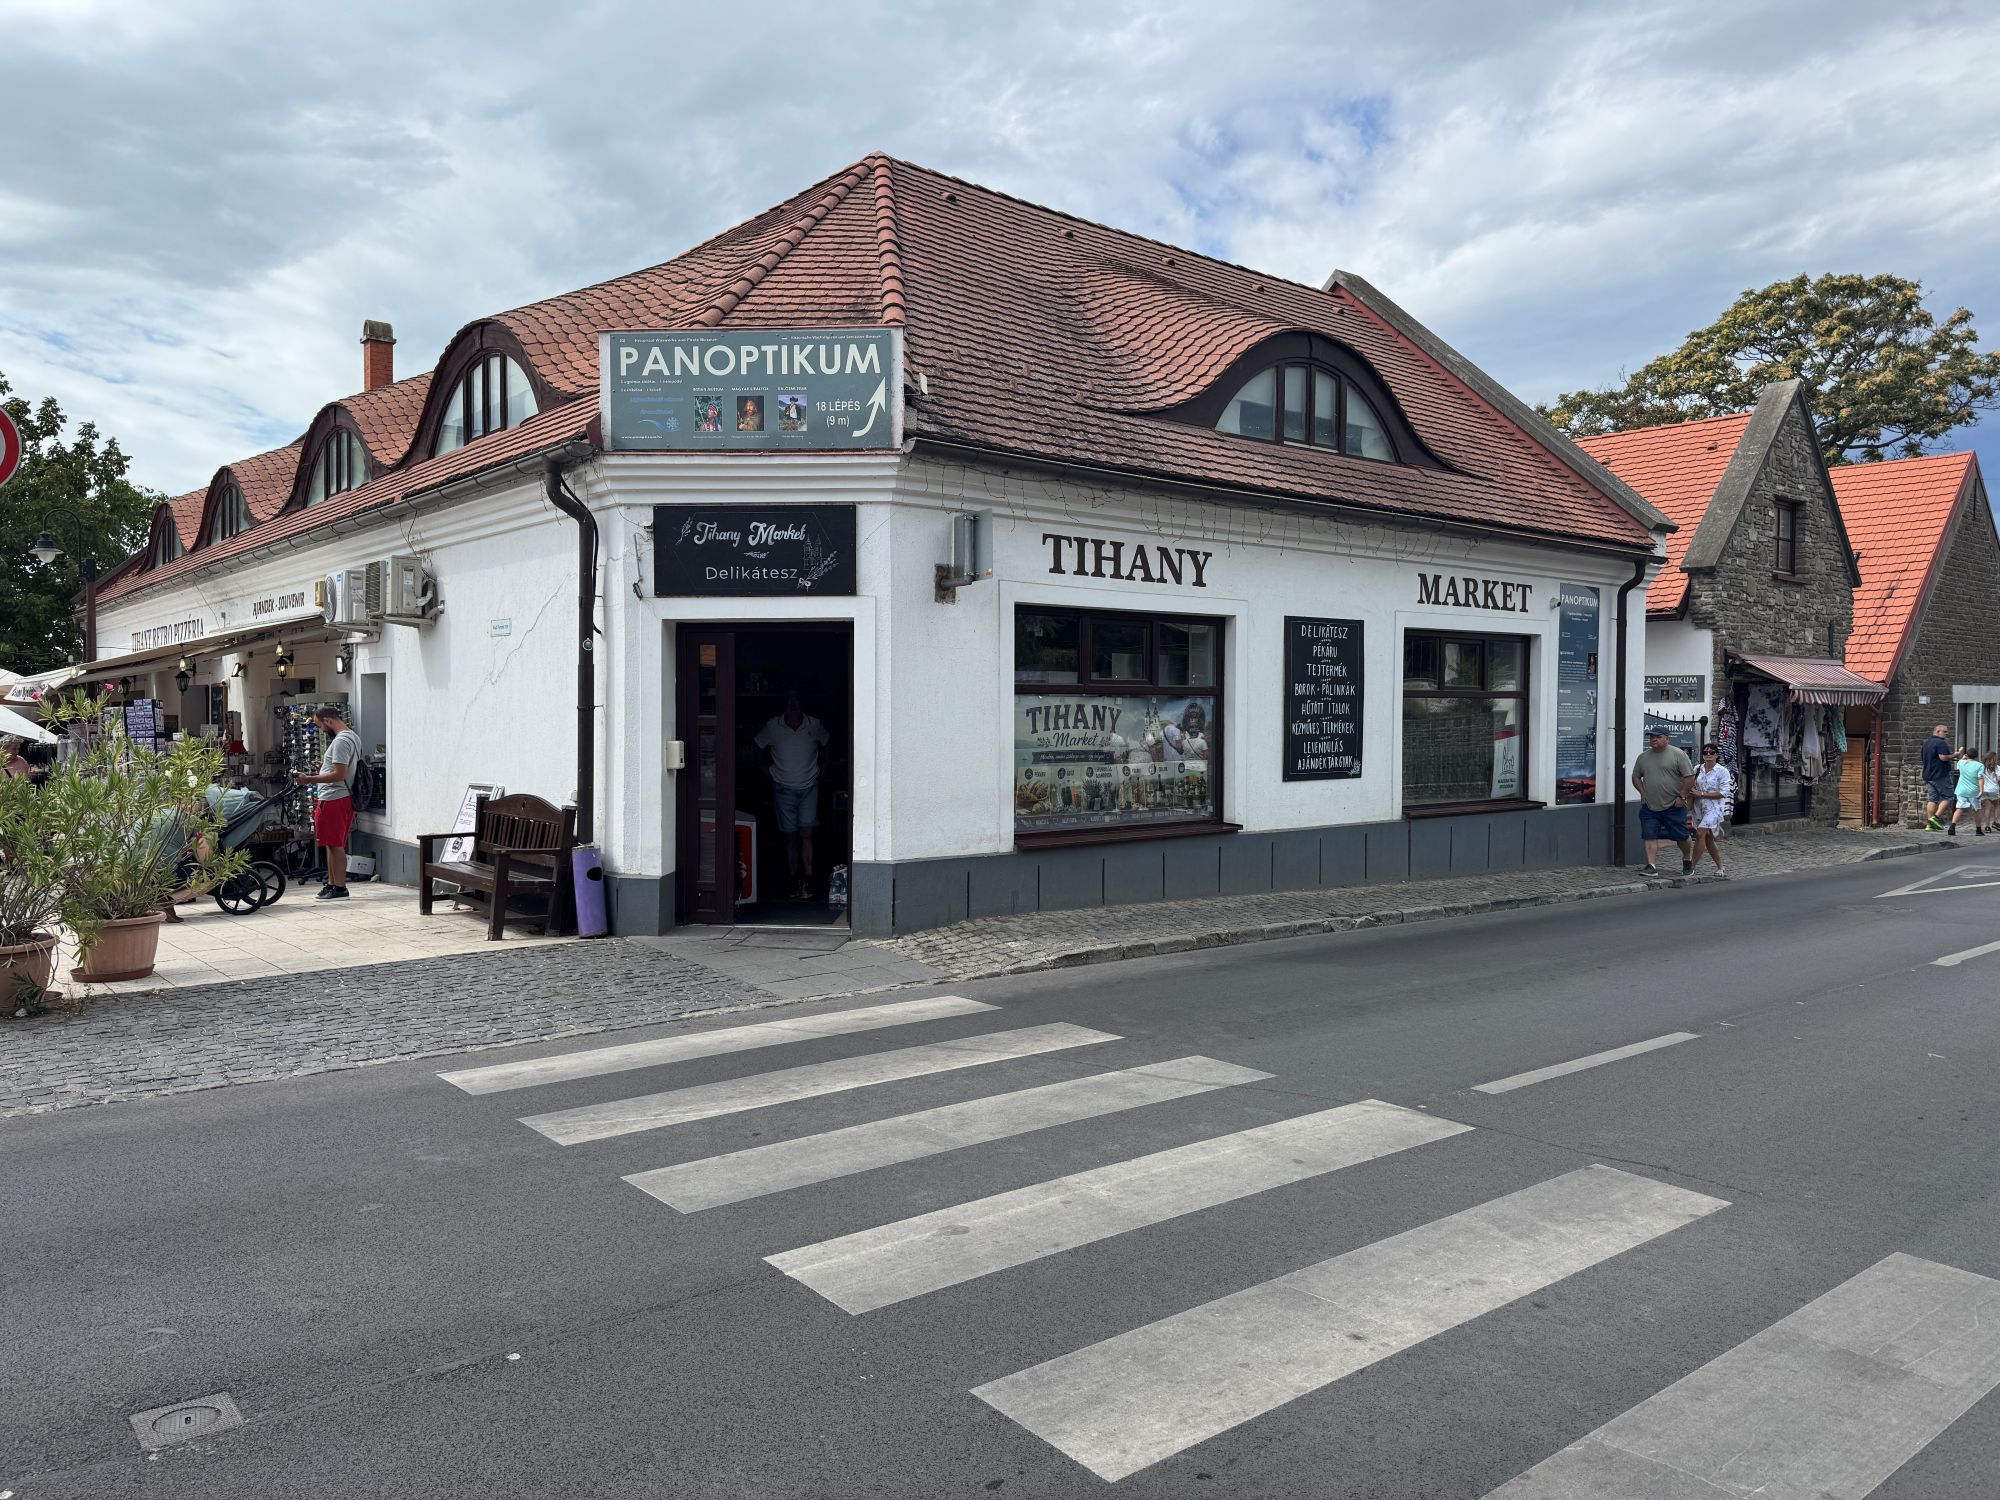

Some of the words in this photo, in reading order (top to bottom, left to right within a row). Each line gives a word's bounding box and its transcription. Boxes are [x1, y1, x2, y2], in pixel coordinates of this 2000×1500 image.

[619, 343, 881, 377] PANOPTIKUM
[815, 401, 827, 412] 18
[829, 398, 861, 412] LÉPÉS
[826, 415, 836, 428] (9
[837, 415, 850, 428] m)
[694, 521, 741, 547] Tihany
[748, 521, 806, 546] Market
[1042, 533, 1213, 587] TIHANY
[706, 566, 799, 580] Delikátesz
[1417, 573, 1533, 612] MARKET
[1561, 594, 1599, 607] PANOPTIKUM
[252, 593, 275, 620] AJÁNDÉK
[278, 591, 305, 611] SOUVENIR
[132, 629, 152, 653] TIHANY
[152, 624, 173, 649] RETRO
[174, 613, 204, 643] PIZZÉRIA
[1301, 624, 1349, 640] DELIKÁTESZ
[1312, 642, 1338, 658] PÉKÁRU
[1306, 662, 1348, 678] TEJTERMÉK
[1645, 676, 1698, 684] ANOPTIKUM
[1294, 683, 1316, 697] BOROK
[1321, 681, 1356, 696] PÁLINKÁK
[1328, 702, 1351, 715] ITALOK
[1025, 703, 1122, 735] TIHANY
[1322, 719, 1355, 734] TERMÉKEK
[1053, 732, 1099, 748] Market
[1303, 737, 1344, 754] LEVENDULÁS
